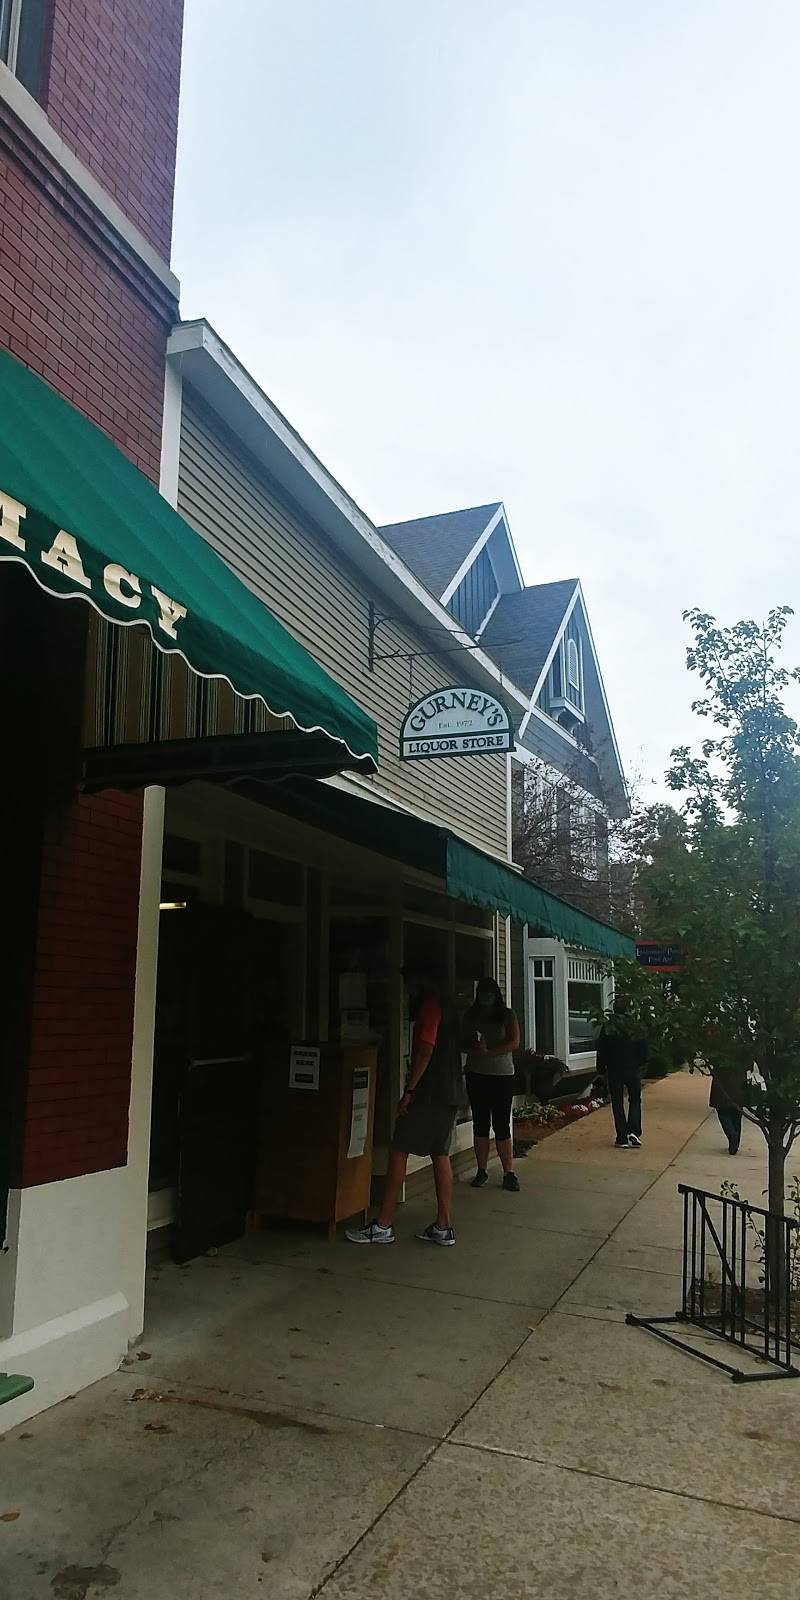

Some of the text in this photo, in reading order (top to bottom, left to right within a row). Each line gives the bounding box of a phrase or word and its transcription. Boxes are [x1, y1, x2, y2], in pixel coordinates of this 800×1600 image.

[410, 692, 504, 731] GURNEY'S
[409, 736, 504, 753] LIQUOR STORE
